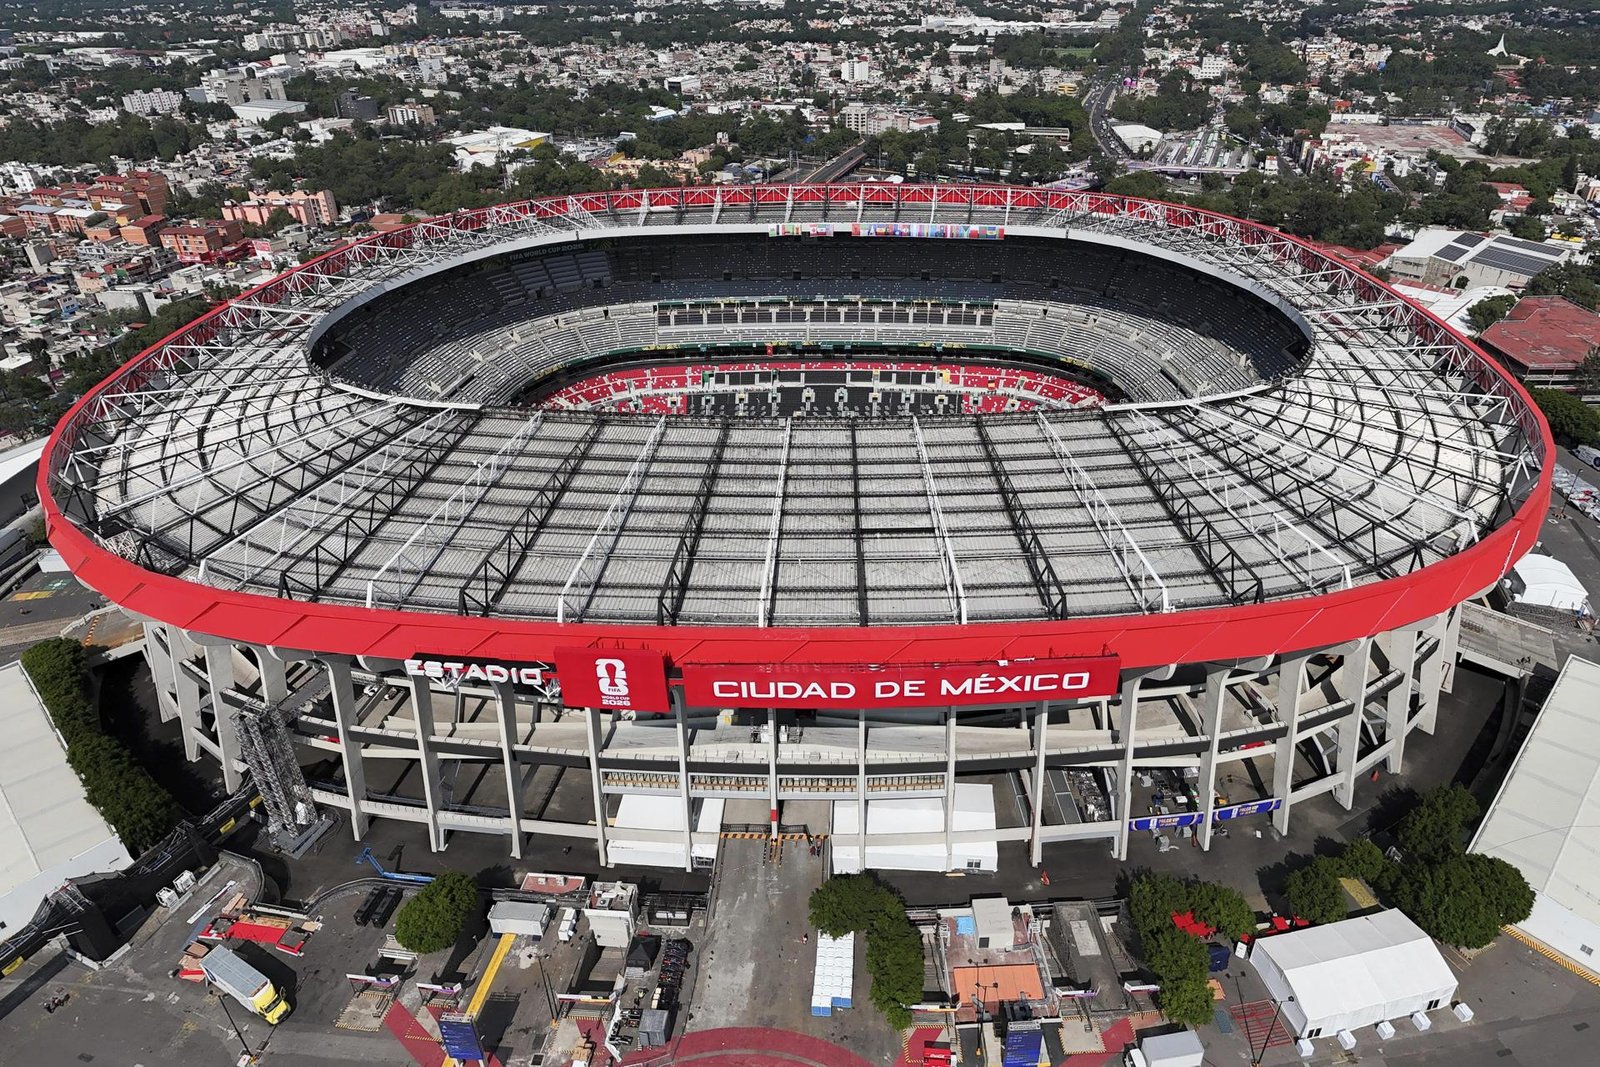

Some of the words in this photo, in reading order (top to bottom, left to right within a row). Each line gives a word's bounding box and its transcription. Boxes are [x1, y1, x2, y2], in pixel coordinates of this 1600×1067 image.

[524, 249, 547, 258] WORLD
[404, 659, 542, 685] ESTADIO
[713, 681, 856, 699] CIUDAD
[875, 680, 926, 698] DE
[941, 672, 1090, 696] MÉXICO
